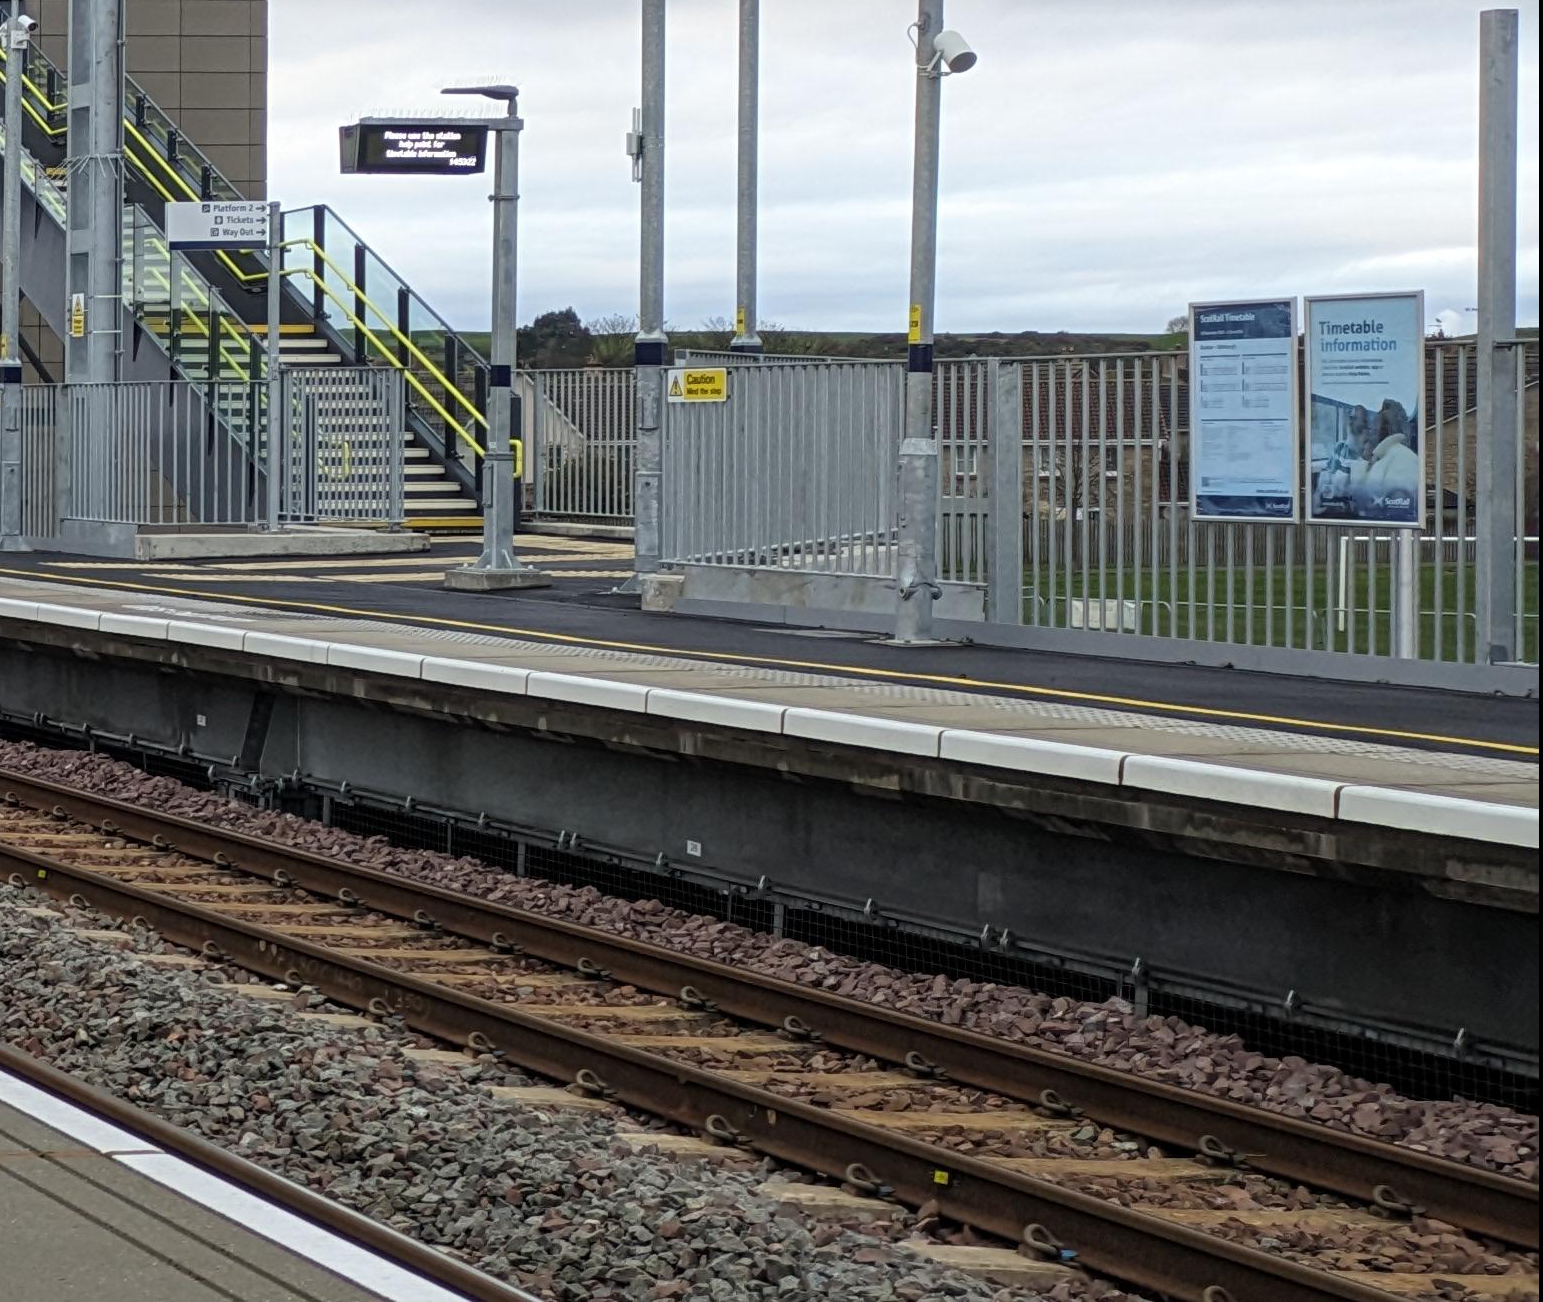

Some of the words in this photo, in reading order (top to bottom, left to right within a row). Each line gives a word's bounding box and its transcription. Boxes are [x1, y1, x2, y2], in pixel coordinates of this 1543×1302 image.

[213, 204, 247, 212] Platform
[248, 204, 254, 212] 2
[227, 216, 254, 224] Tickets
[222, 228, 238, 238] Way
[240, 228, 254, 236] Out
[1319, 319, 1384, 336] Timetable
[1321, 337, 1397, 352] information
[686, 373, 716, 385] Caution
[700, 387, 709, 395] the
